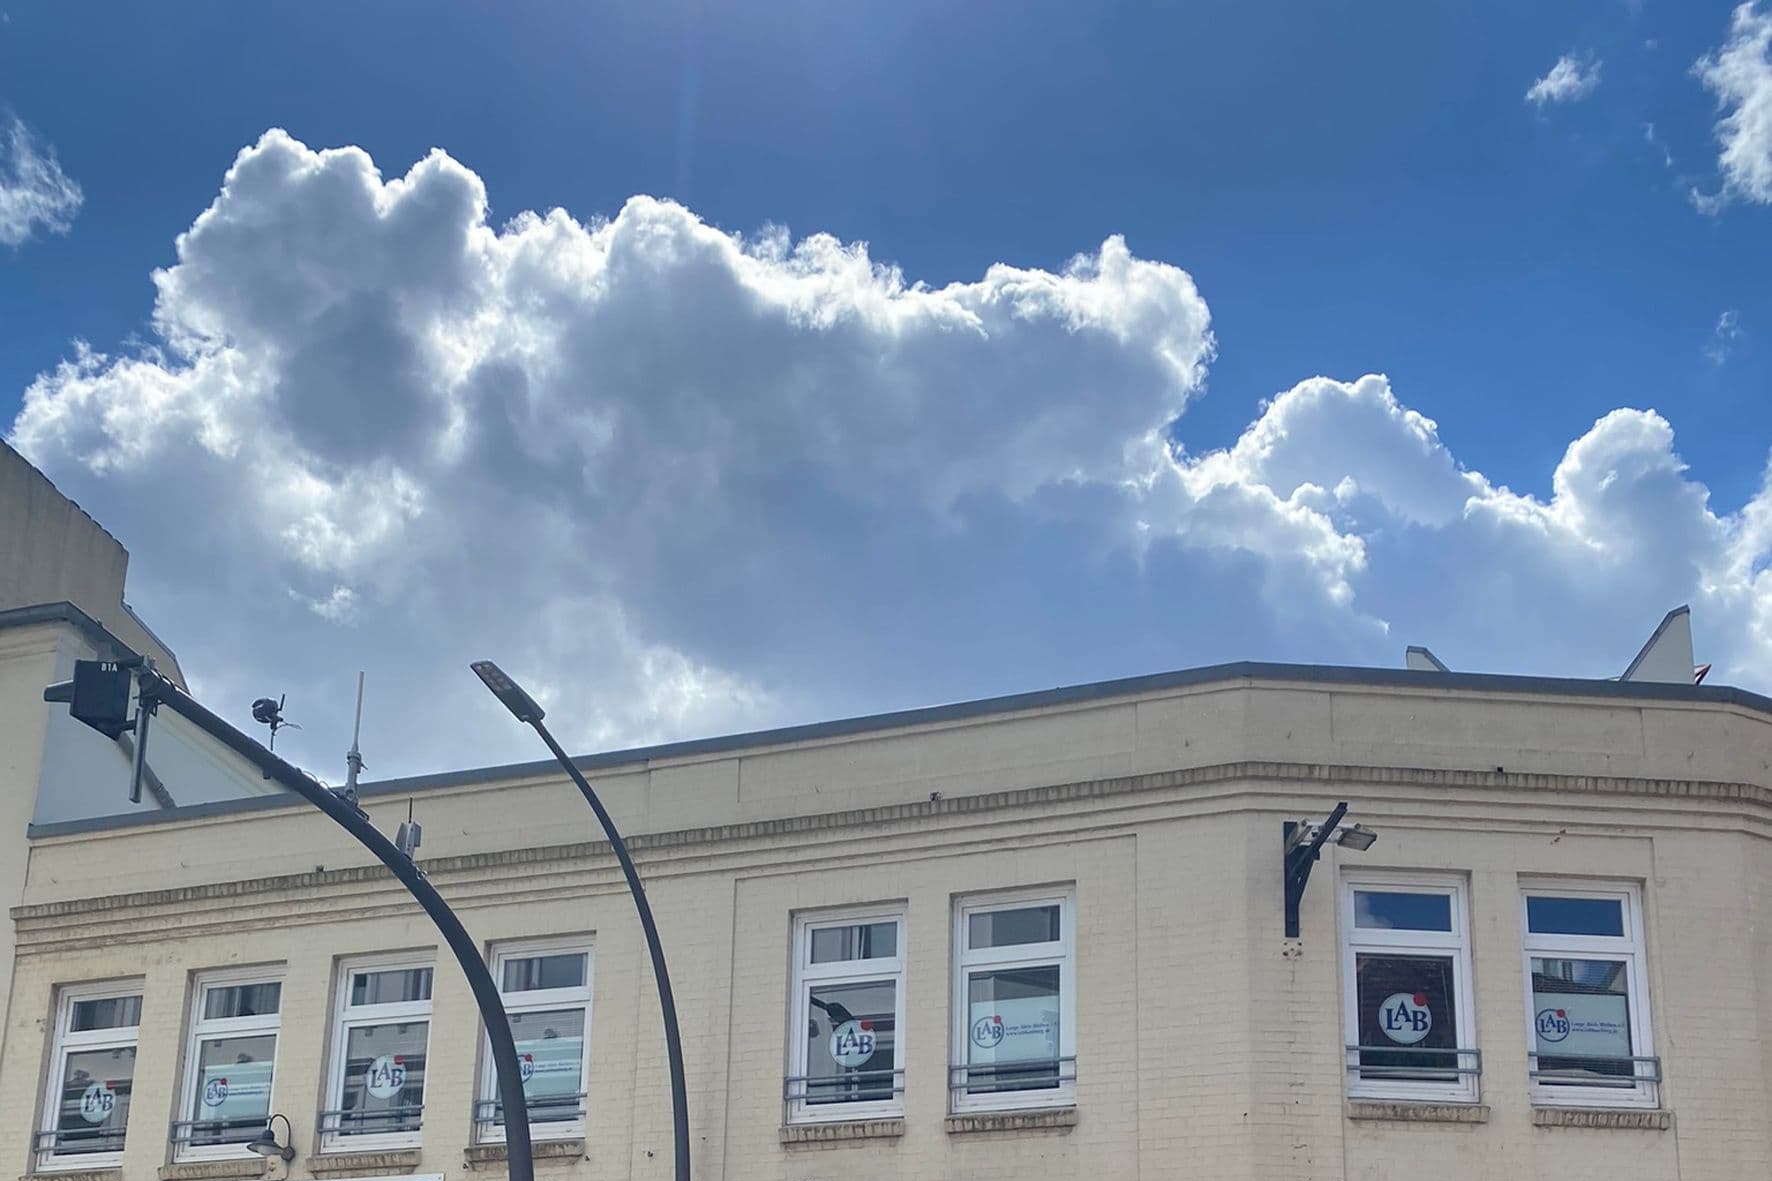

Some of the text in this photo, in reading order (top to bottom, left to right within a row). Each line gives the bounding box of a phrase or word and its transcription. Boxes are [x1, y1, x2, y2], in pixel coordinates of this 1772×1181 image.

[1385, 1000, 1428, 1032] LAB
[1540, 1014, 1567, 1034] LAB
[836, 1028, 873, 1056] LAB
[976, 1022, 1002, 1041] LAB
[370, 1062, 403, 1089] LAB
[84, 1087, 113, 1112] LAB
[207, 1083, 227, 1100] LAB
